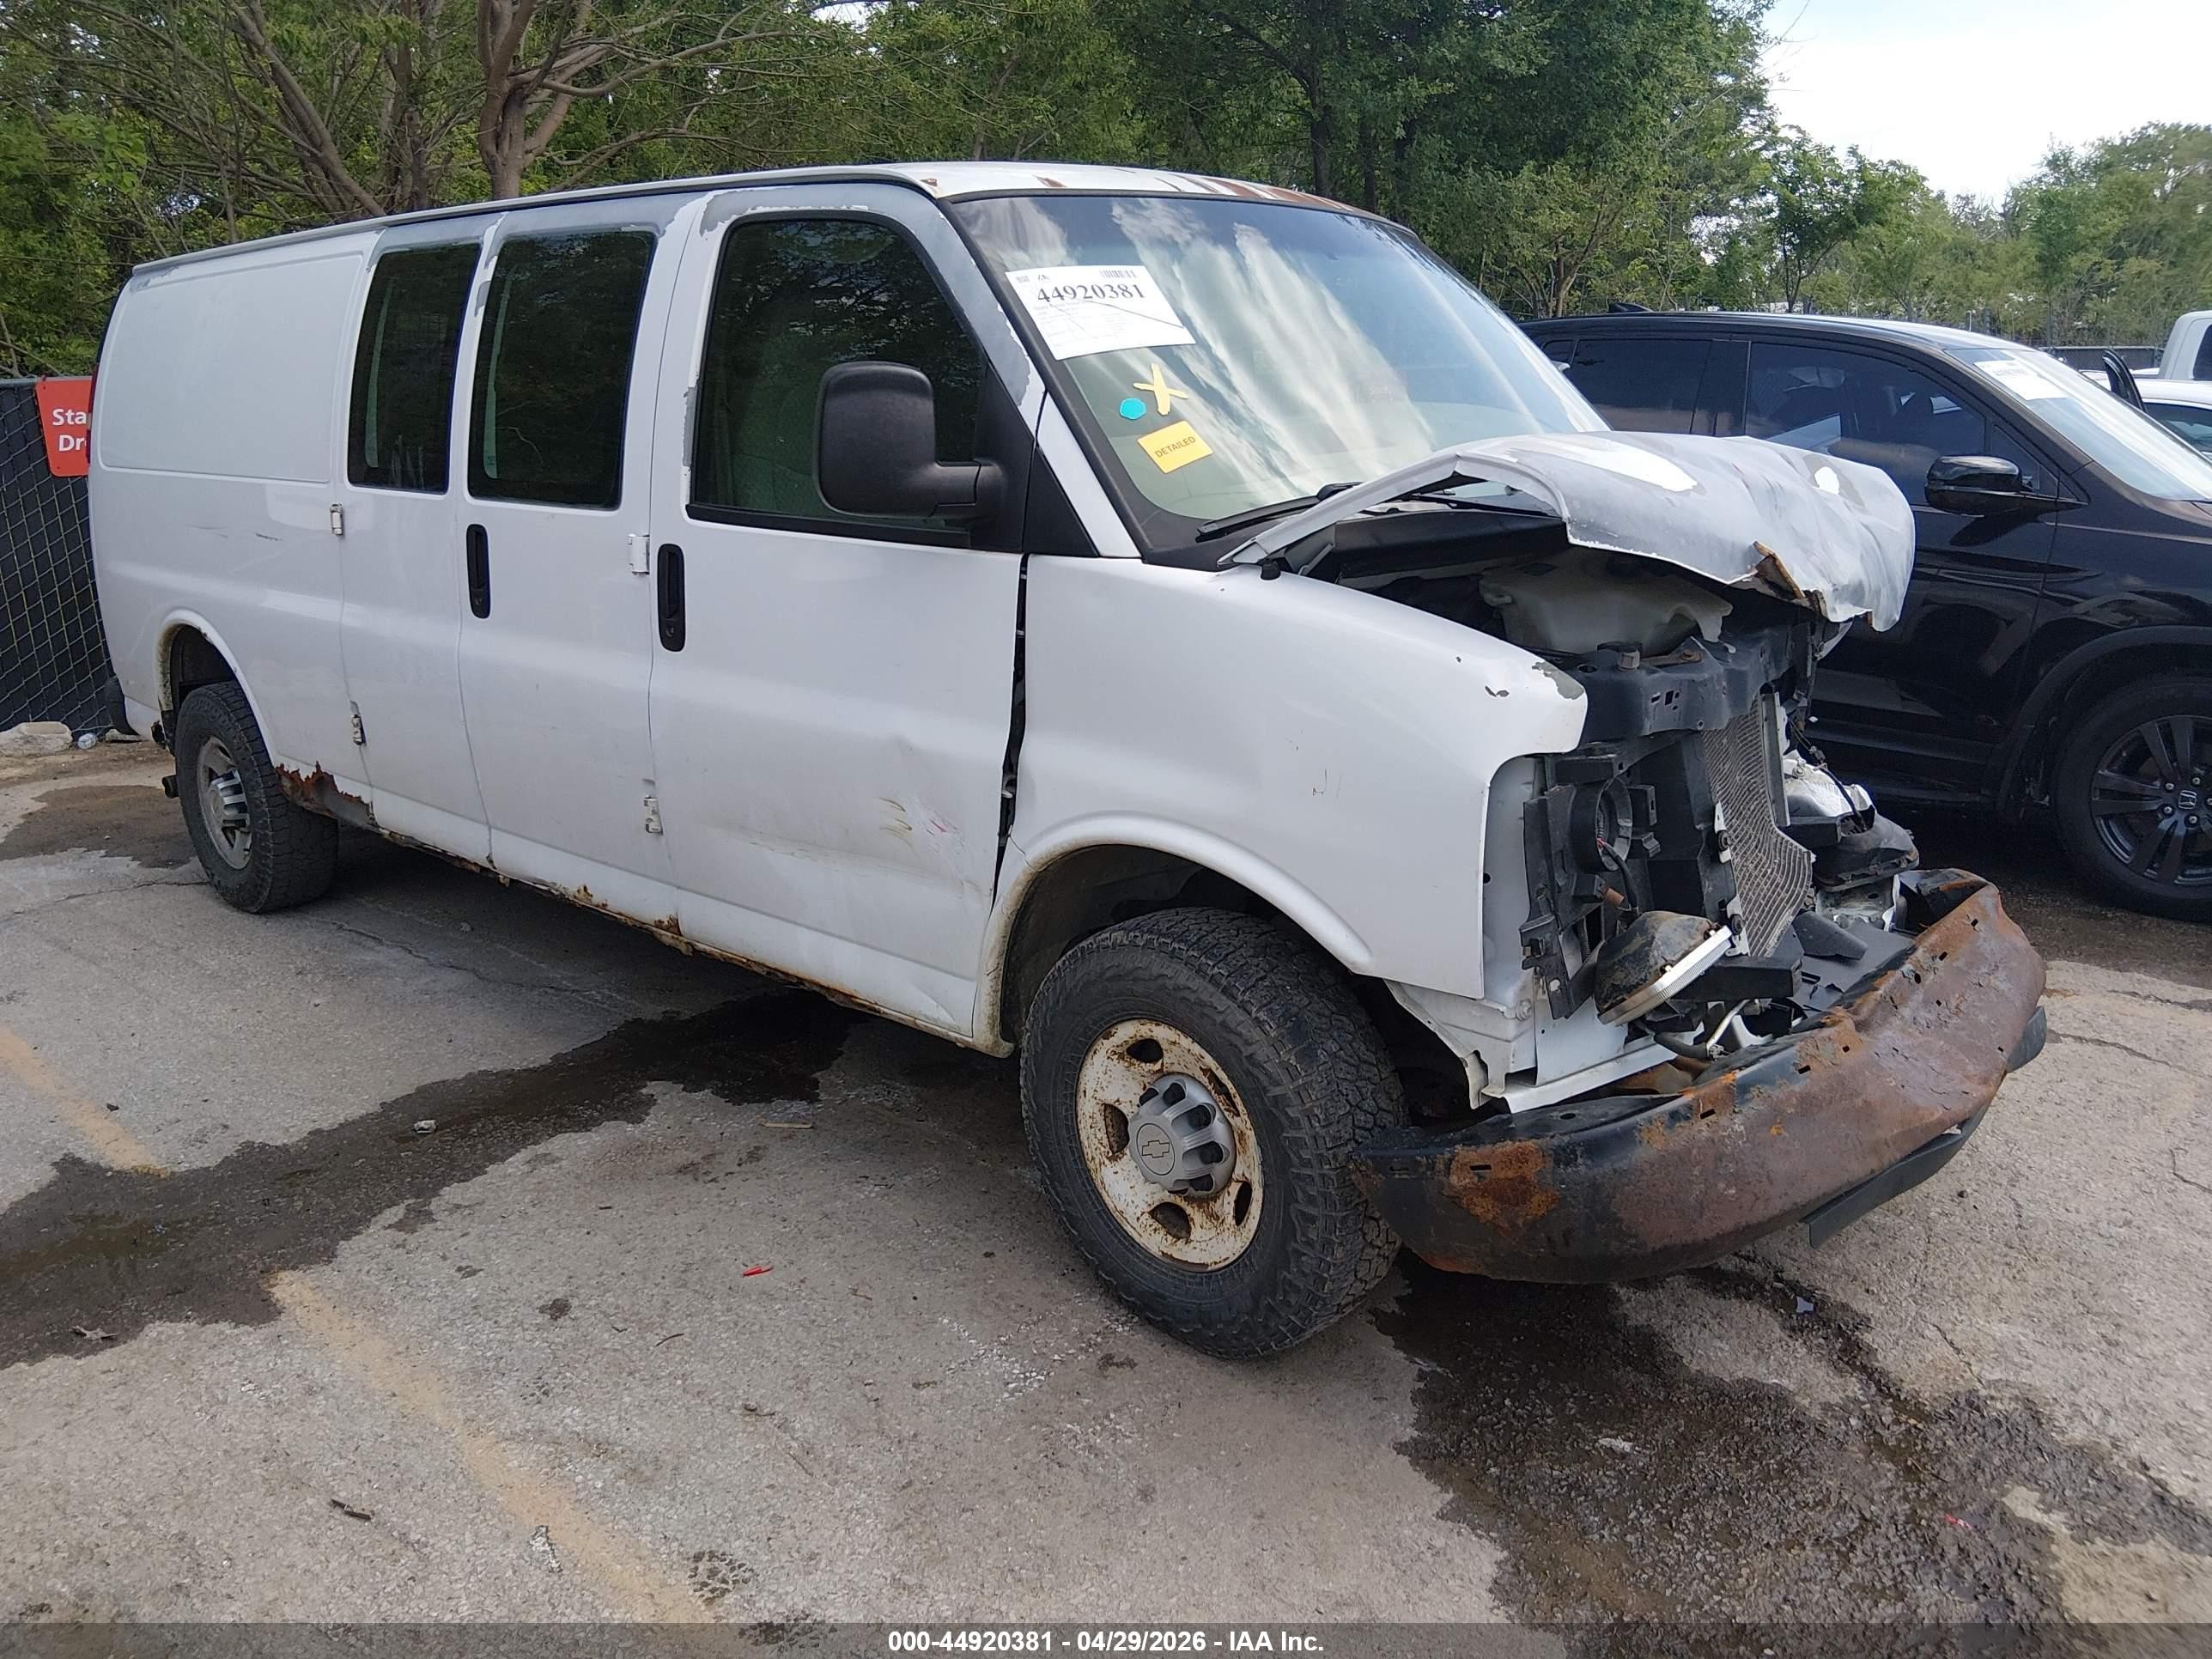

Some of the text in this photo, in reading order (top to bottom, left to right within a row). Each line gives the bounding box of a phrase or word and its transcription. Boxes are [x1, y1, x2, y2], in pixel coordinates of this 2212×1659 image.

[1037, 283, 1146, 302] 44920381
[58, 434, 87, 452] Dr
[1154, 436, 1196, 458] DETAILED
